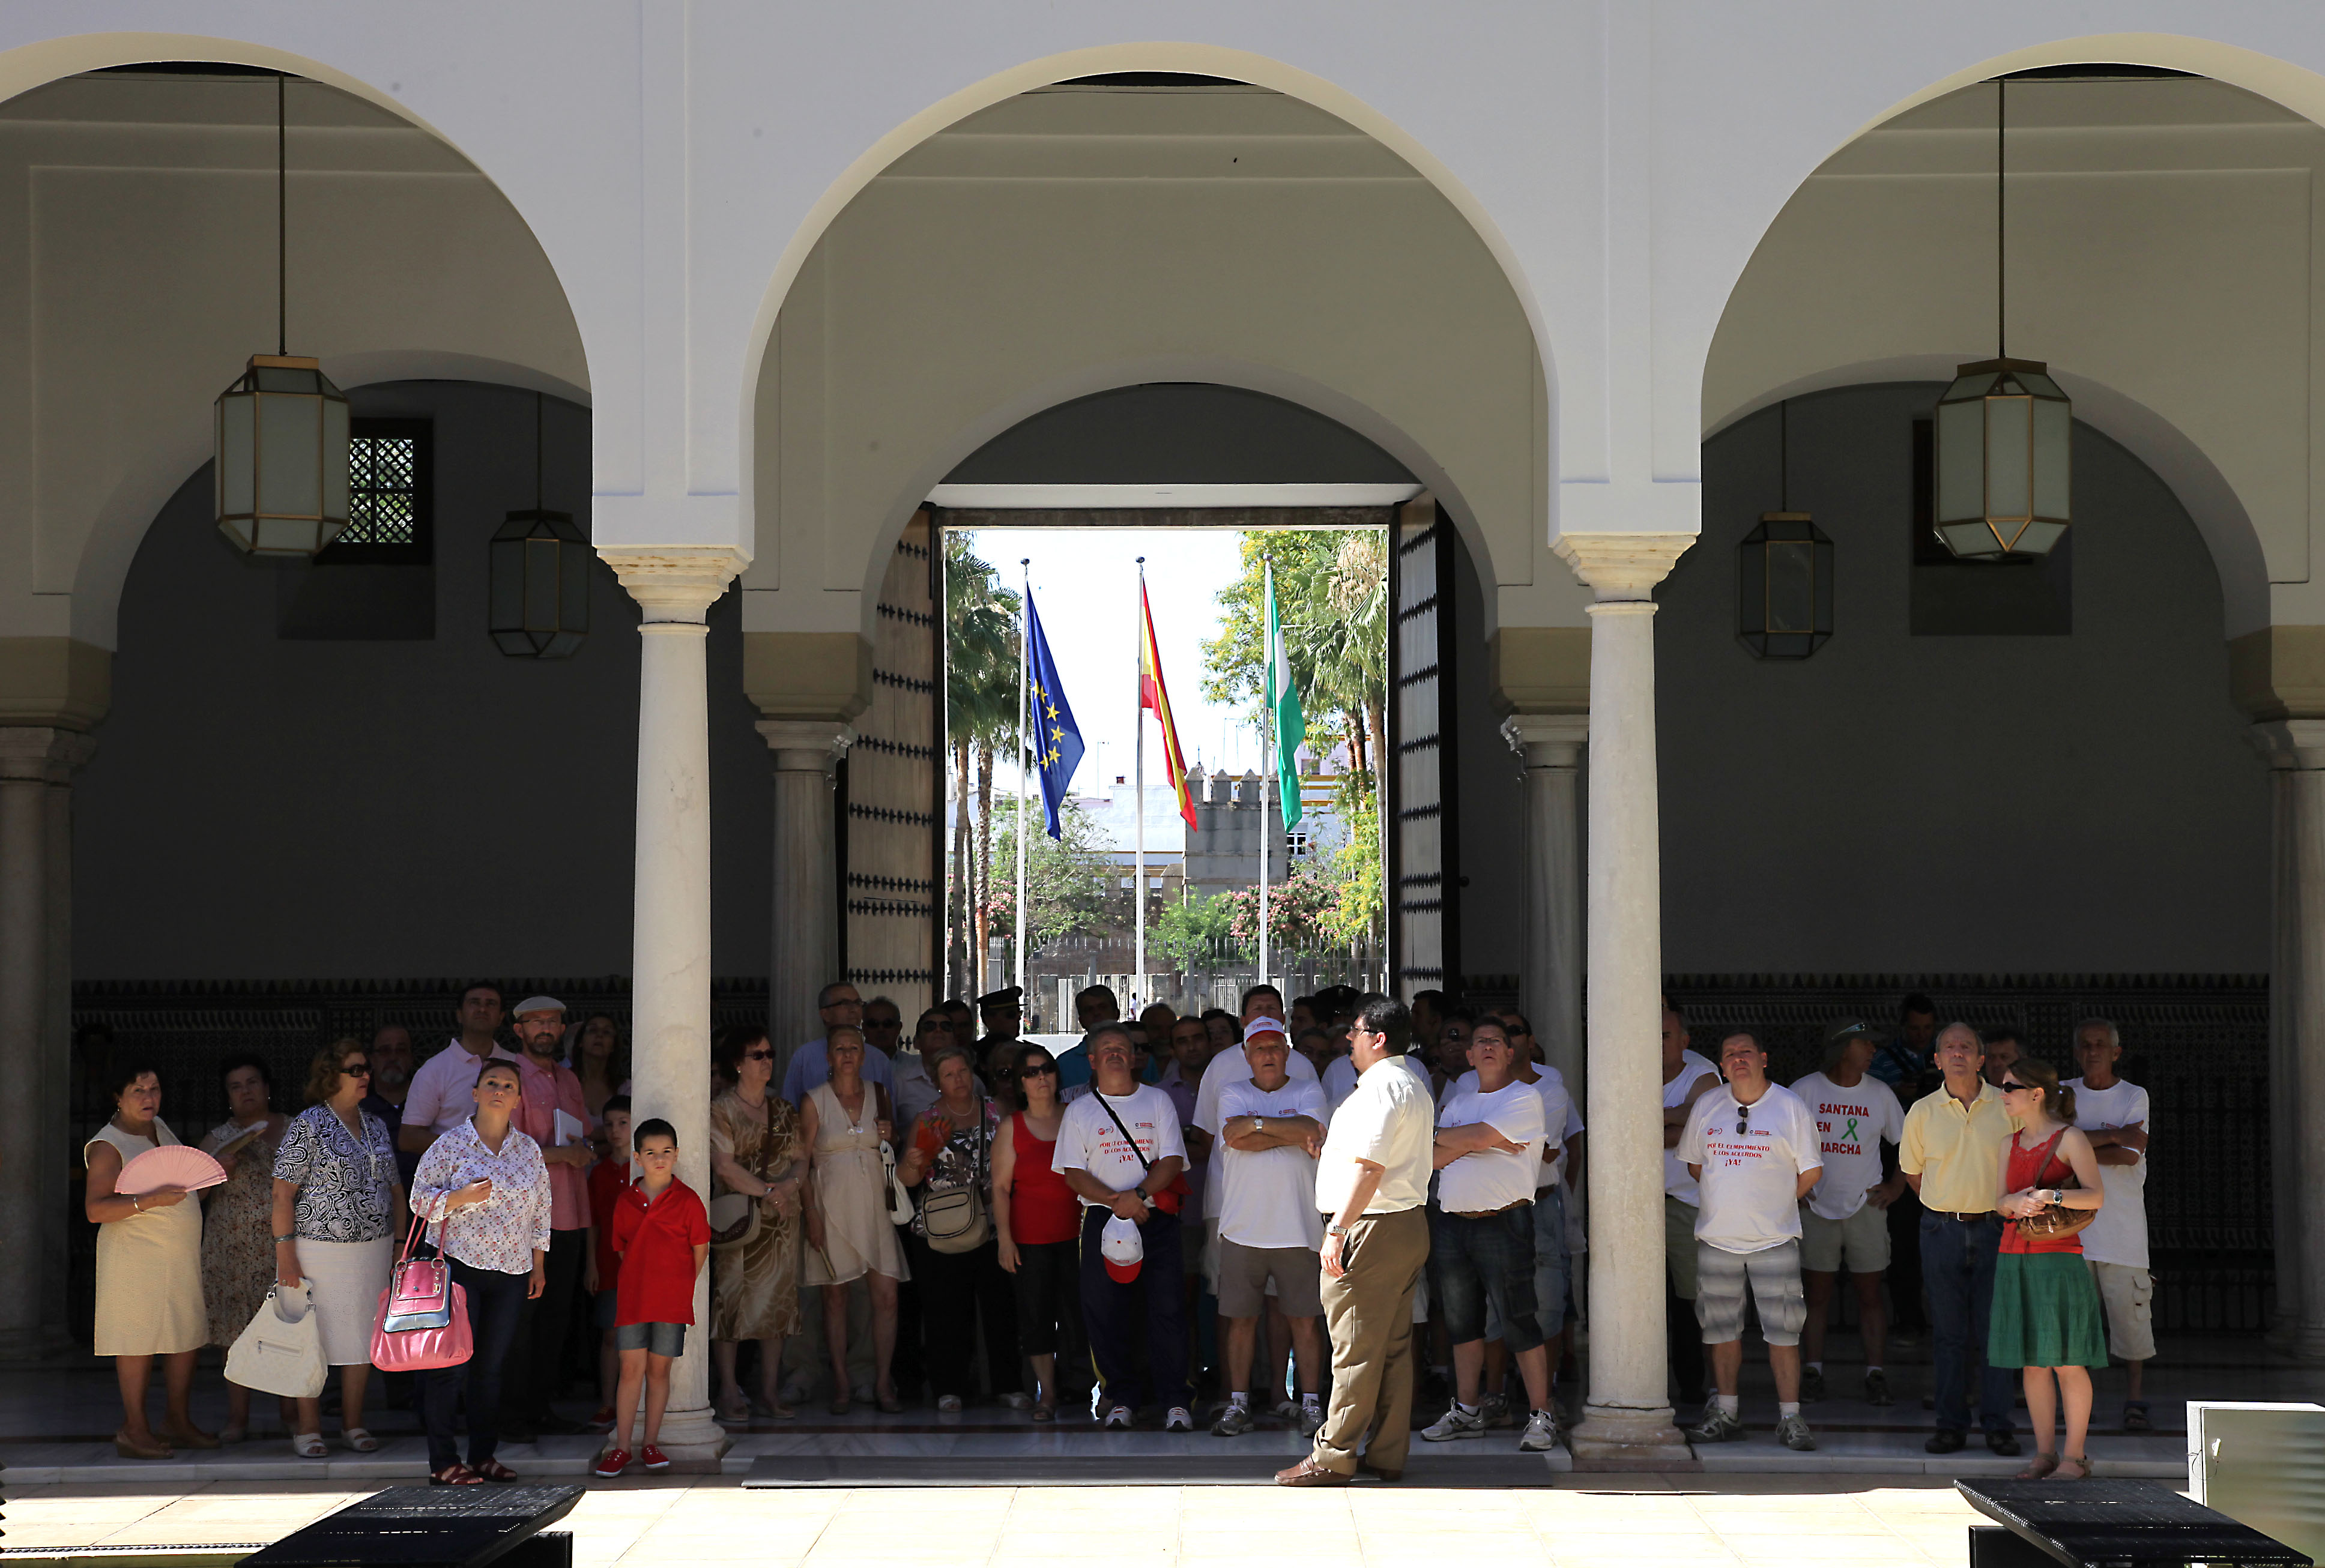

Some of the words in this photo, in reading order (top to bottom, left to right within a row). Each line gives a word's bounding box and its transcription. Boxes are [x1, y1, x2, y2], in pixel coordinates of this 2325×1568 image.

[1819, 1103, 1869, 1117] SANTANA
[1816, 1121, 1831, 1133] EN
[1119, 1154, 1134, 1163] ¡YA!
[1725, 1159, 1741, 1167] ¡YA!
